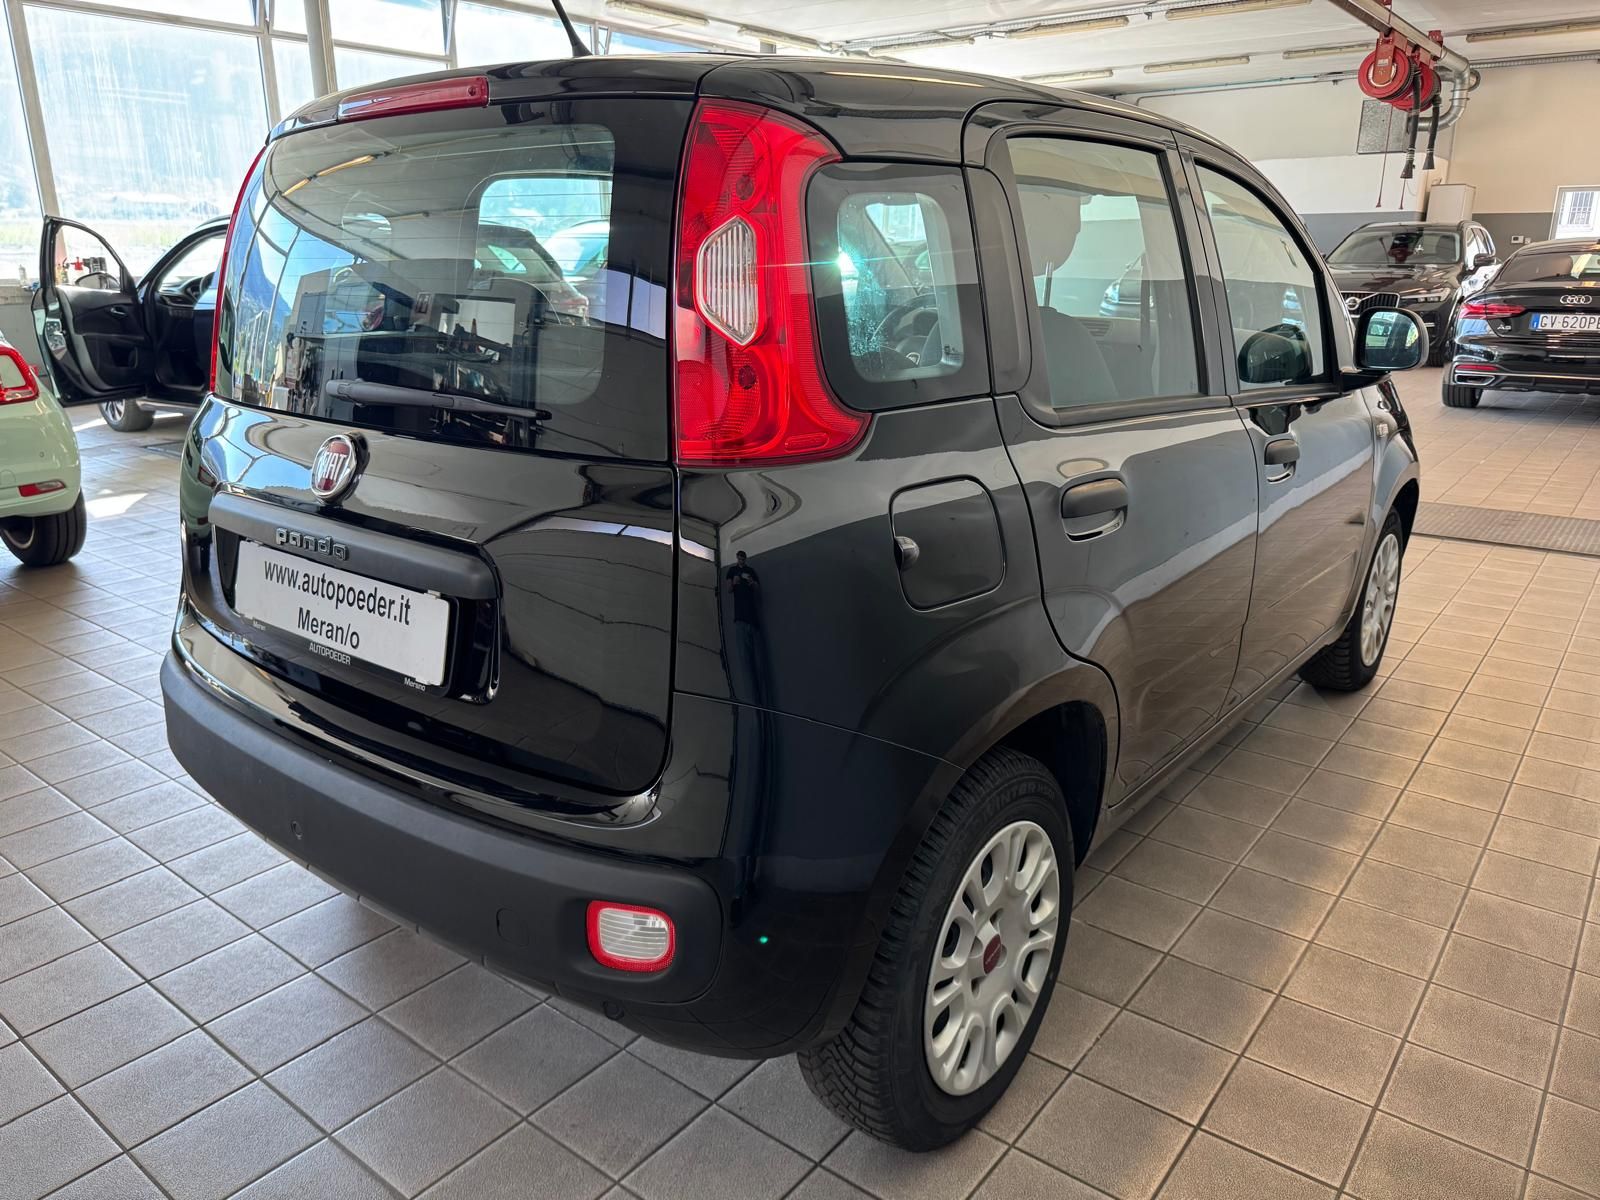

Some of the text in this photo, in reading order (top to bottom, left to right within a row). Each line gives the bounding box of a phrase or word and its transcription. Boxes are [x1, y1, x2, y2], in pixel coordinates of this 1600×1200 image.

[318, 449, 347, 482] FIAT
[275, 527, 349, 560] panda
[264, 560, 412, 626] www.autopoeder.it
[297, 606, 360, 650] Meran/o
[308, 642, 352, 666] AUTOPOEDER
[404, 677, 426, 692] Merano
